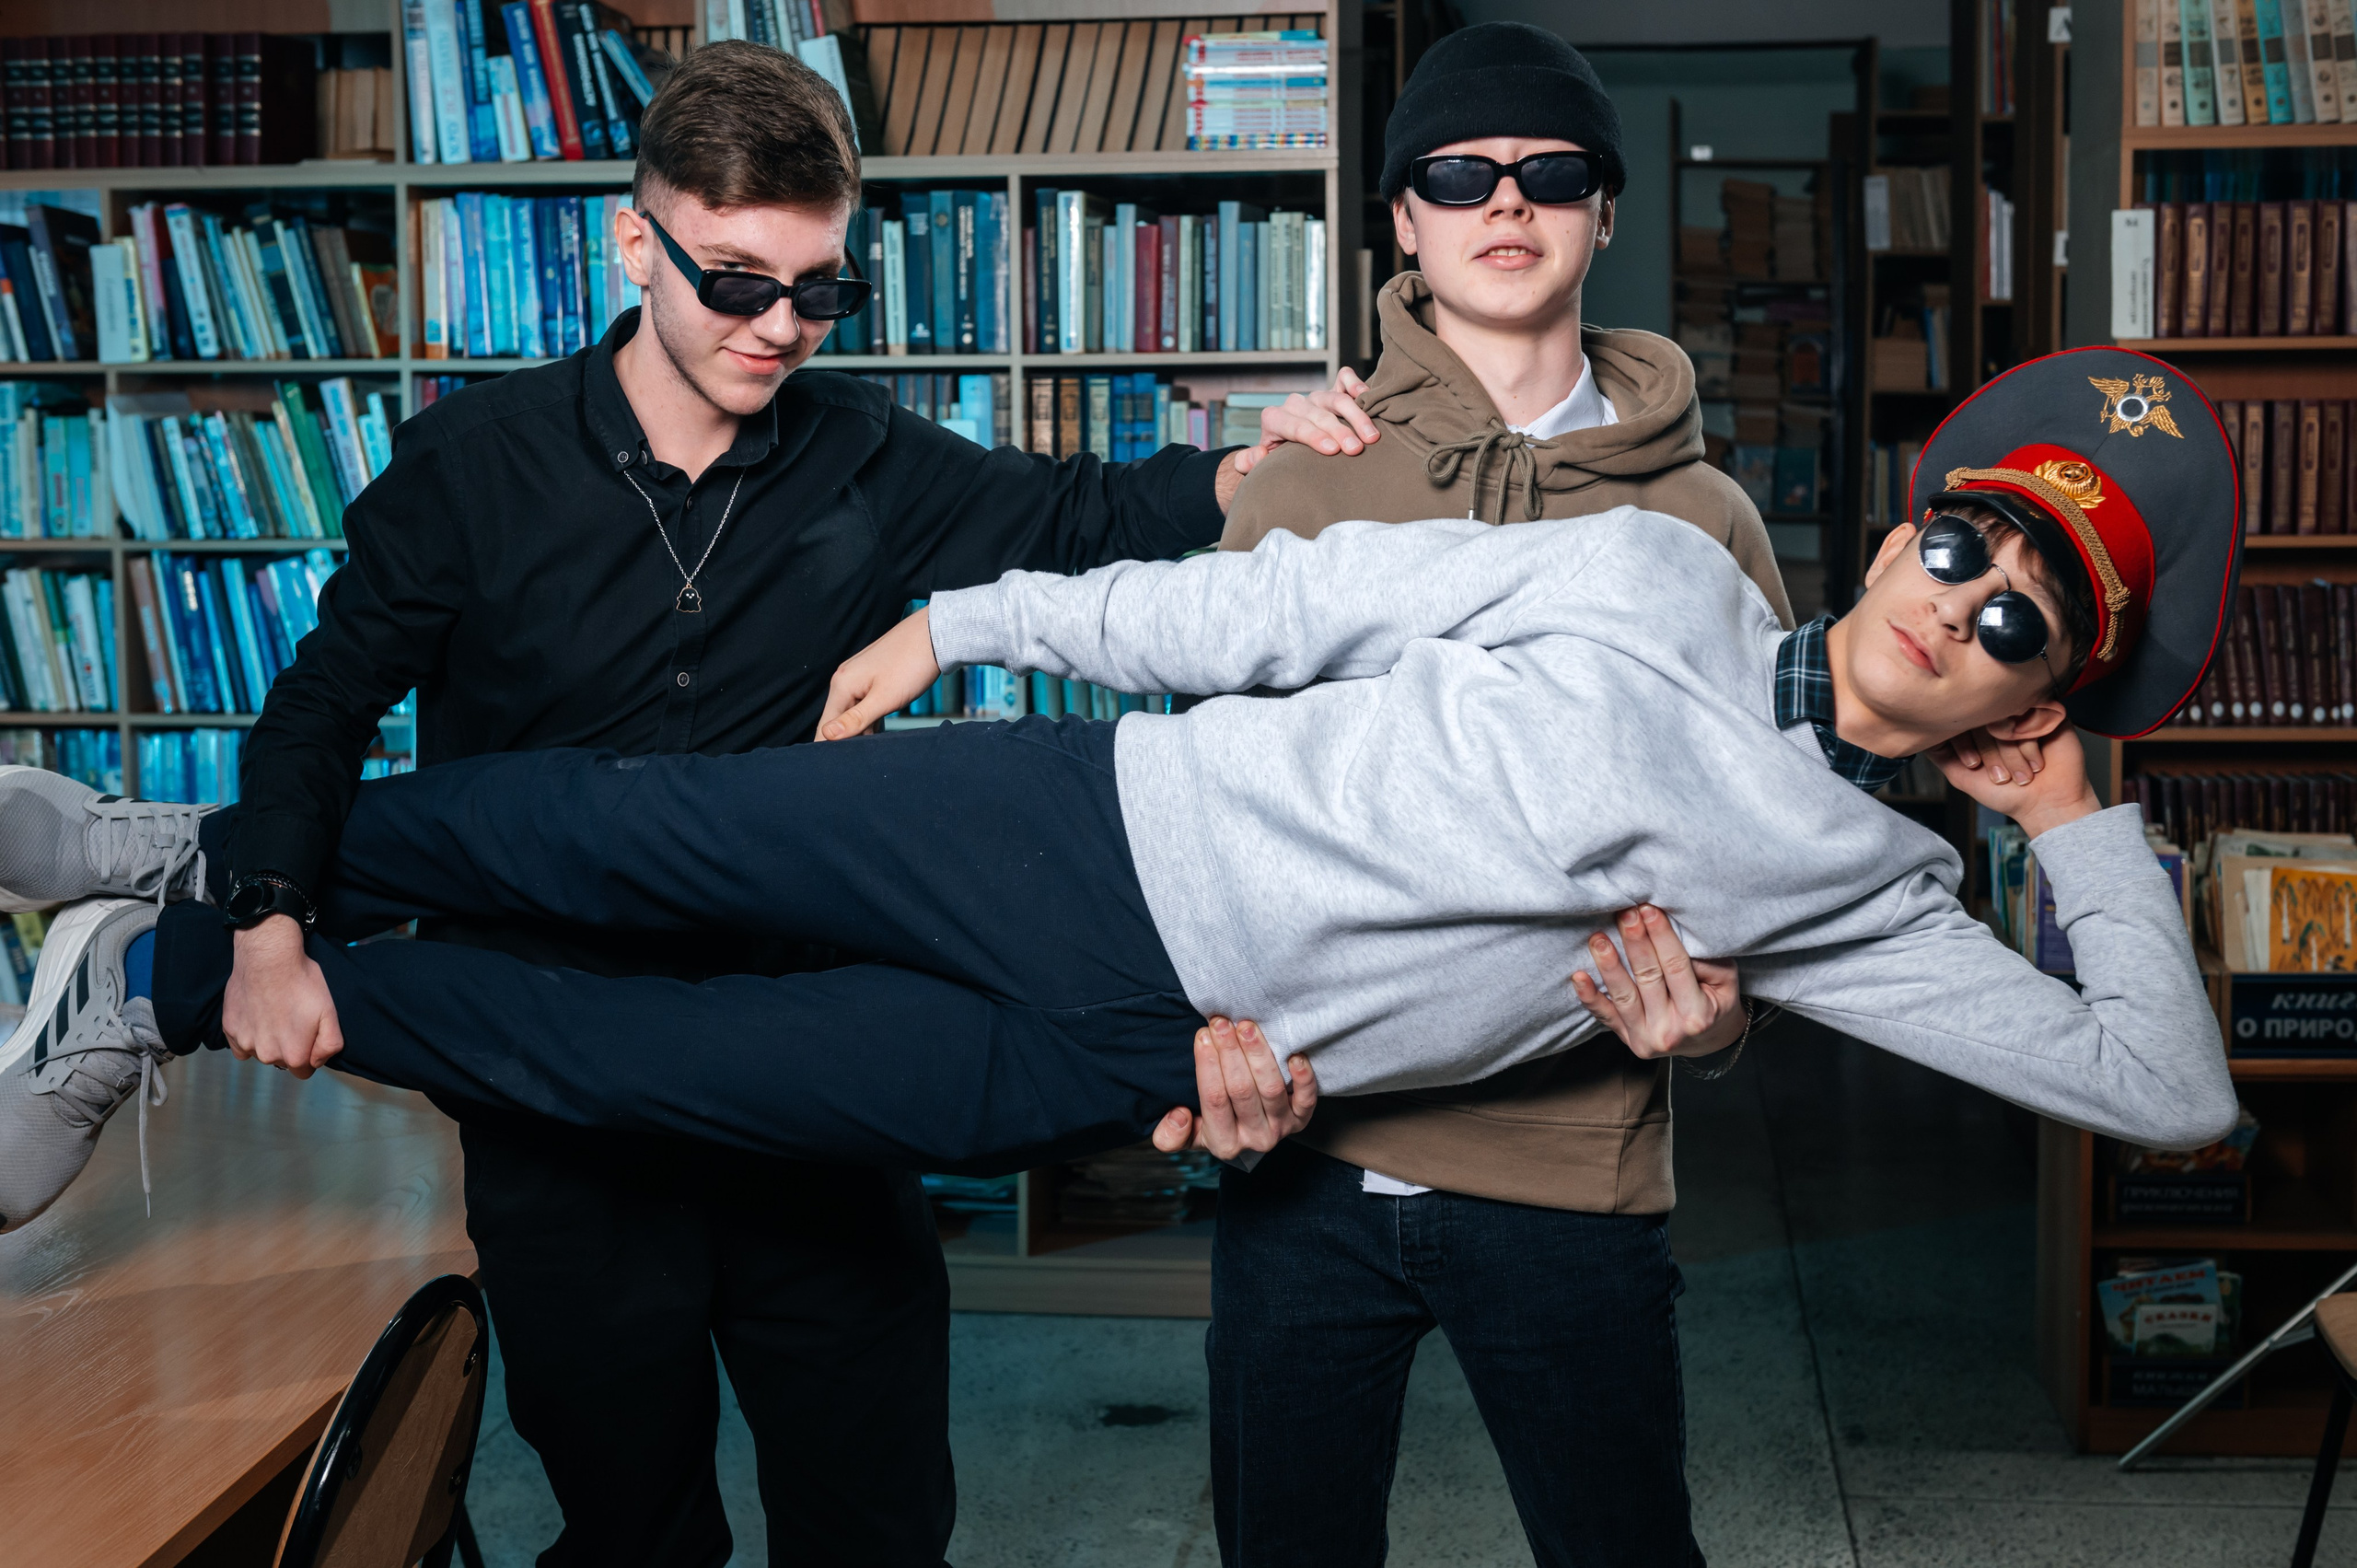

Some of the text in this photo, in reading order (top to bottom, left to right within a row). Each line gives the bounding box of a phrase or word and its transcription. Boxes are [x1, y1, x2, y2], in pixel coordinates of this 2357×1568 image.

[2270, 991, 2357, 1010] книг
[2236, 1017, 2357, 1041] О ПРИРО
[2143, 1309, 2212, 1324] СКАЗКИ
